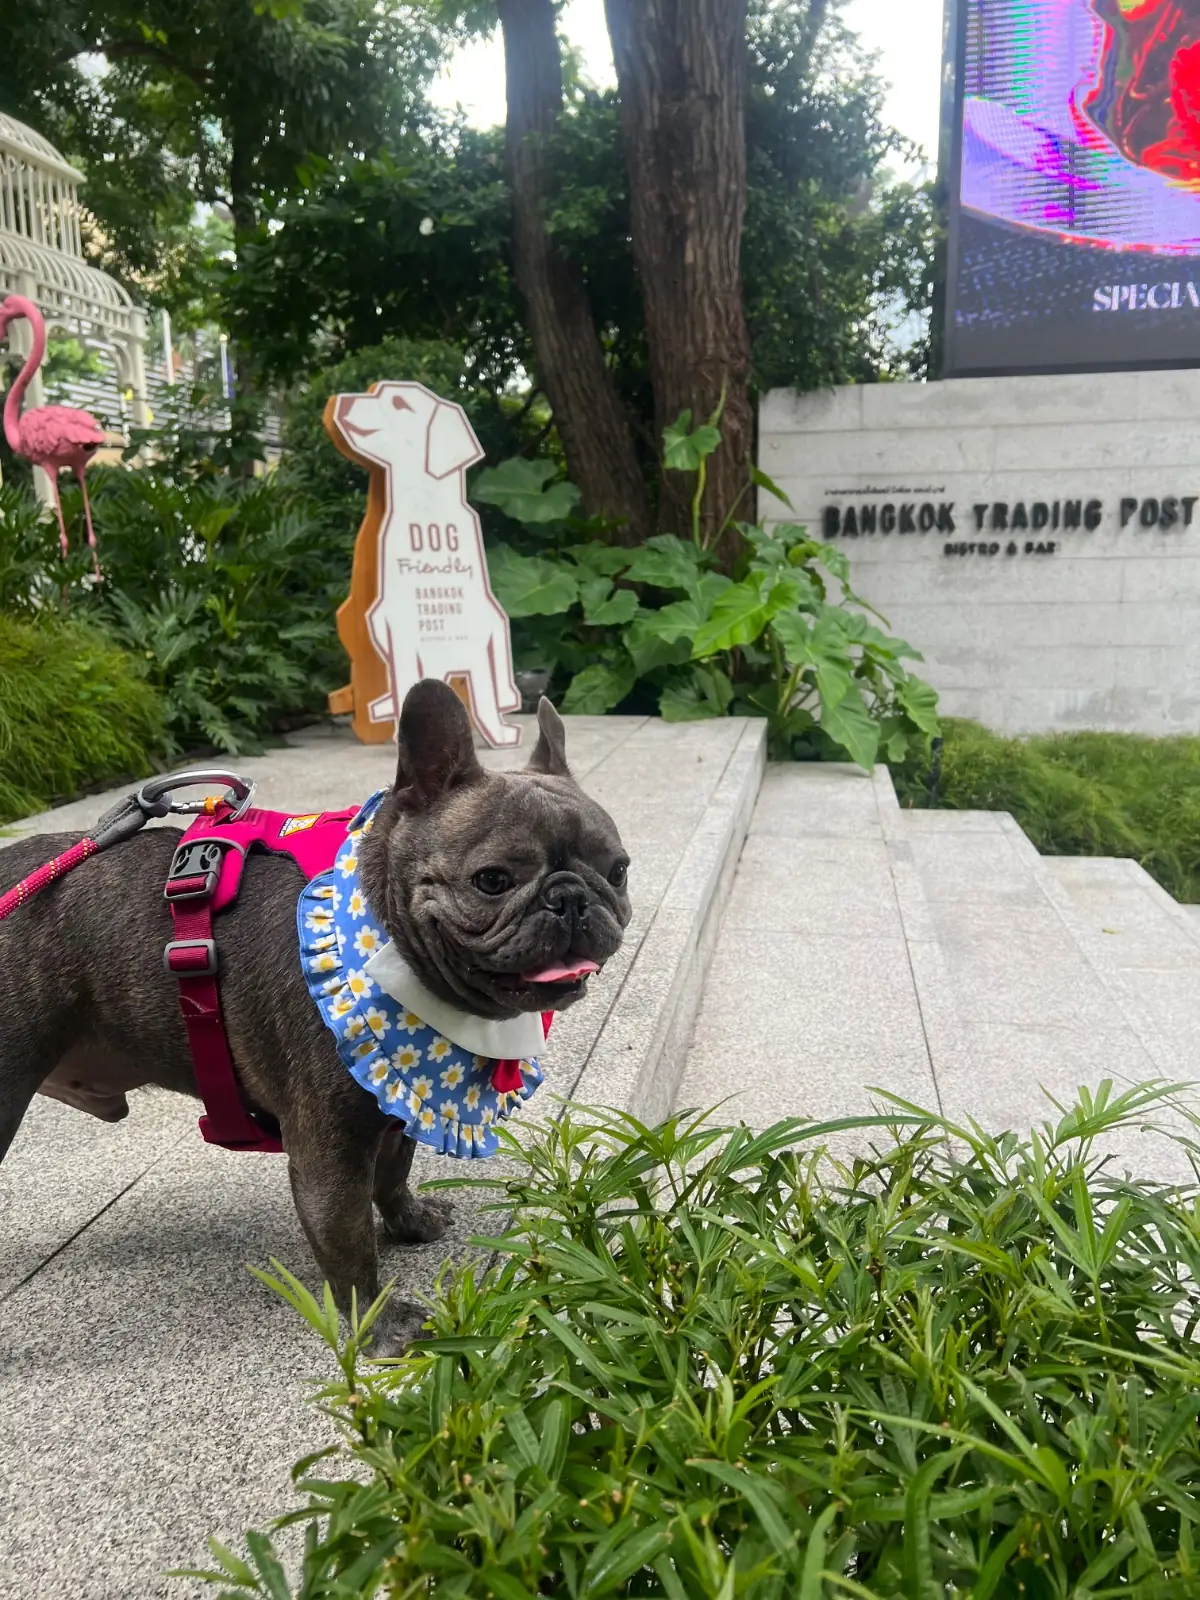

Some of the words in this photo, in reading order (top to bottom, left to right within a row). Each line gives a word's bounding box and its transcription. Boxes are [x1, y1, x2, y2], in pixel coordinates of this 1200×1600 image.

[823, 503, 956, 538] BANGKOK
[973, 500, 1103, 531] TRADING
[1120, 496, 1200, 529] POST
[409, 523, 459, 552] DOG
[396, 556, 474, 579] Friendly
[415, 587, 465, 600] BANGKOK
[417, 603, 463, 616] TRADING
[419, 618, 445, 632] POST
